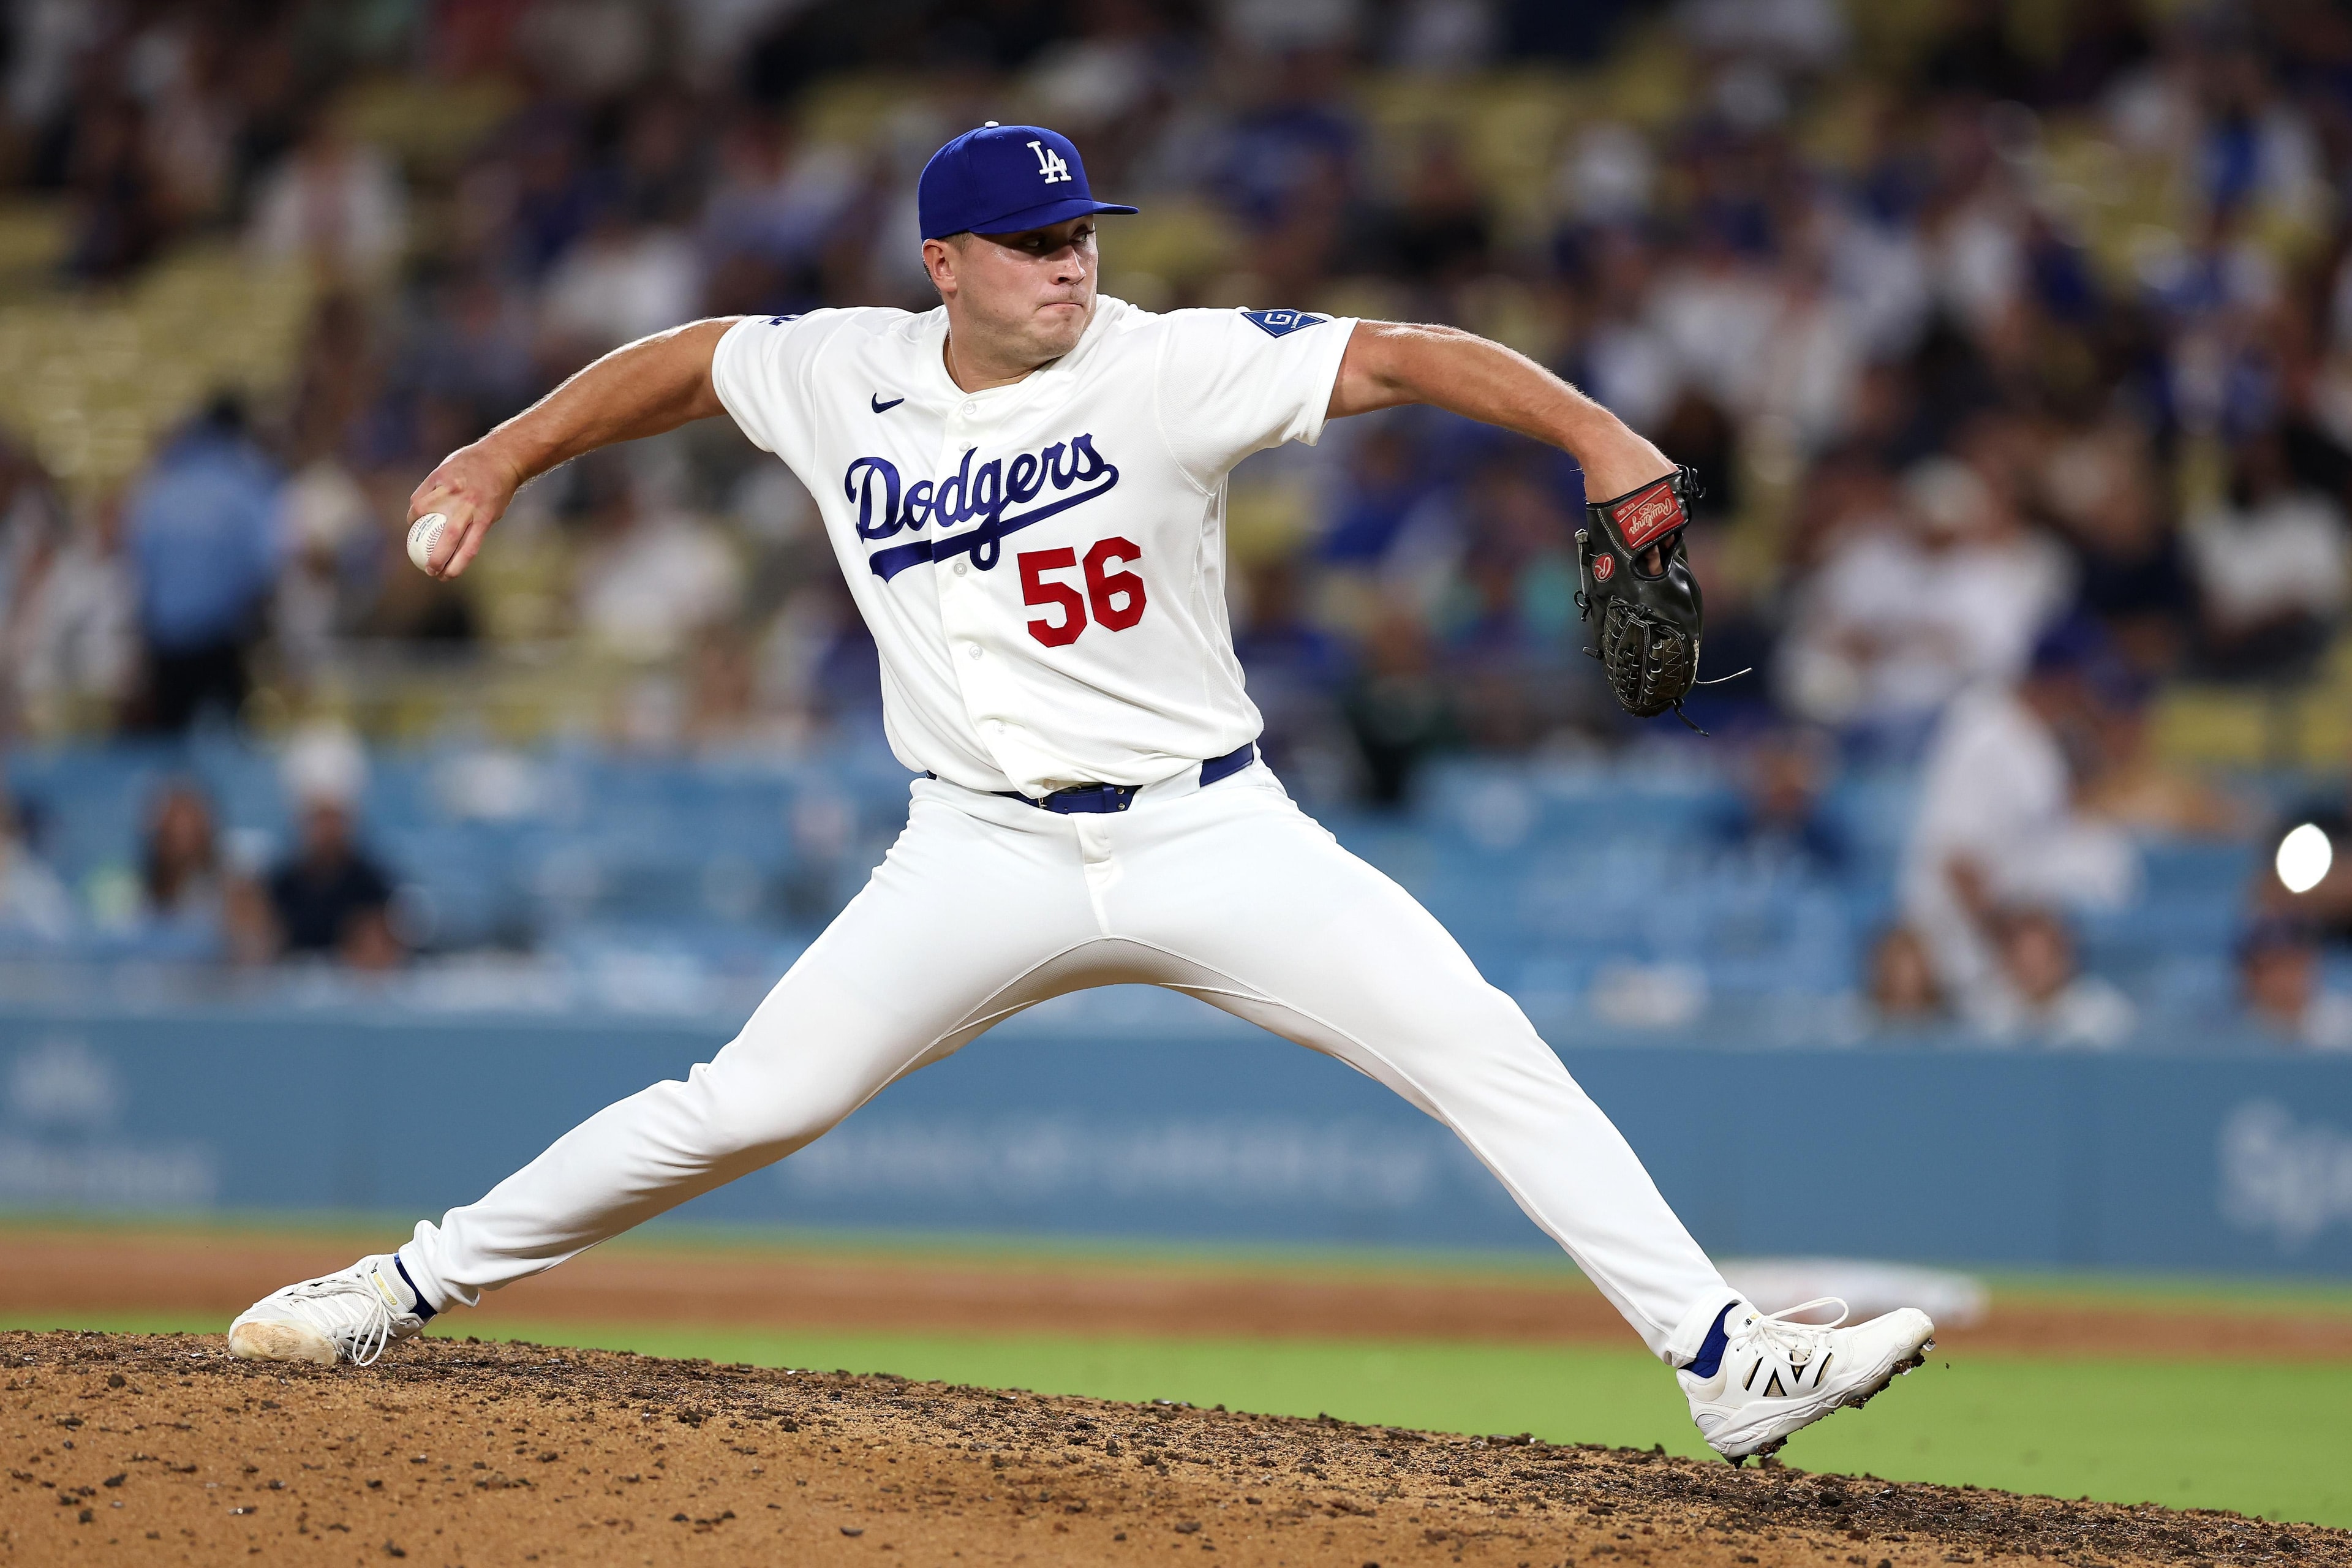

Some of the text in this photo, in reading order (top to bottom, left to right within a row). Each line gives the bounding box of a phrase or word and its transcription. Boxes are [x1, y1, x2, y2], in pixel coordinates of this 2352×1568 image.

[1026, 140, 1072, 184] LA
[845, 433, 1118, 572] Dodgers
[1629, 497, 1672, 535] Rawlings
[1594, 557, 1611, 579] R
[1017, 537, 1147, 648] 56
